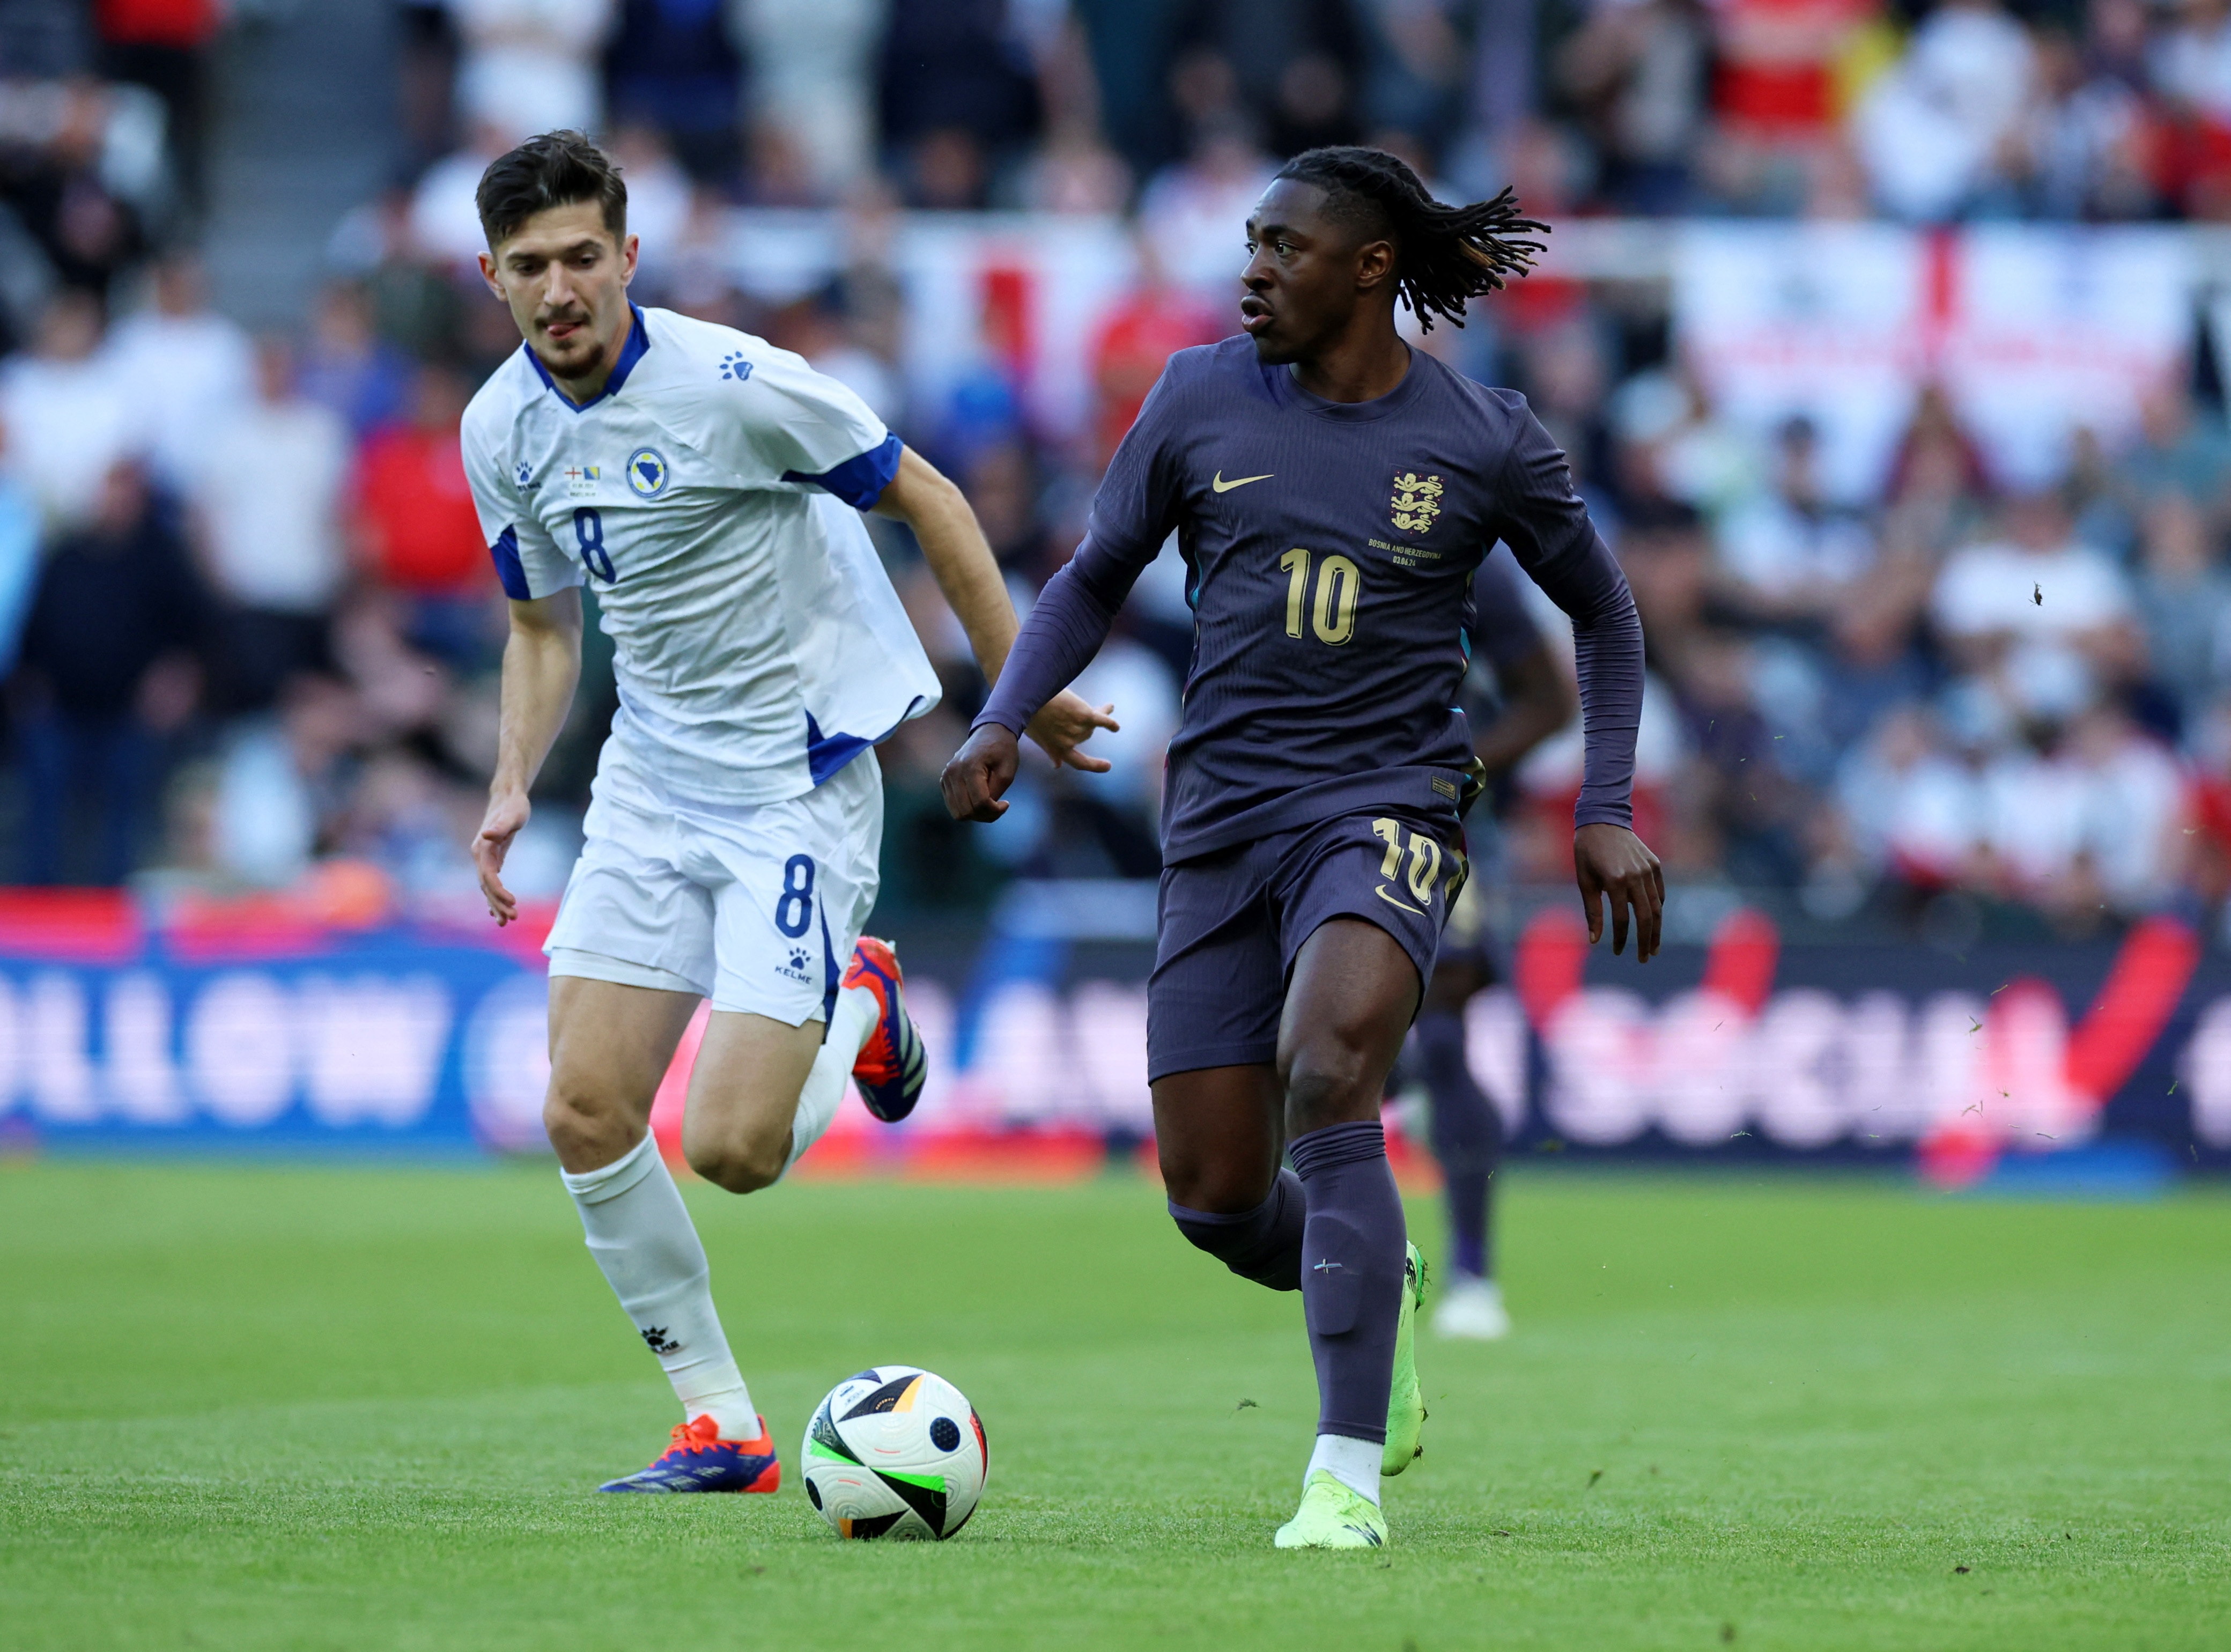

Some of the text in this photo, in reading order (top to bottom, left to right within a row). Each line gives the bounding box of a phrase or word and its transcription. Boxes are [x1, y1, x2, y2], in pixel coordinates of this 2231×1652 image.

[573, 507, 616, 584] 8
[1368, 538, 1442, 559] BOSNIA AND HERZEGOVINA
[1280, 548, 1361, 646] 10
[775, 853, 815, 939] 8
[1372, 817, 1442, 906] 10
[775, 965, 812, 985] KELME
